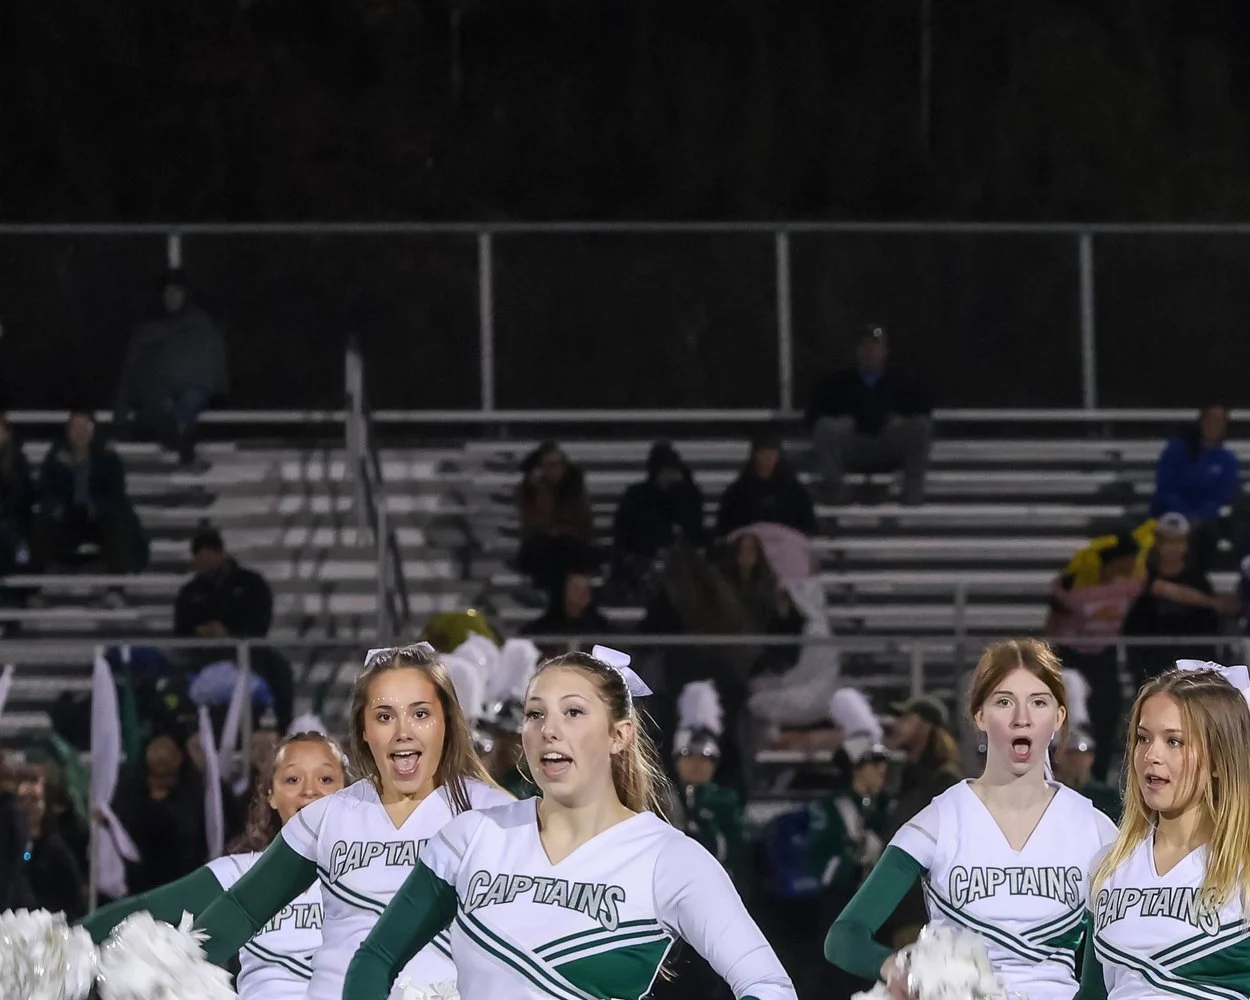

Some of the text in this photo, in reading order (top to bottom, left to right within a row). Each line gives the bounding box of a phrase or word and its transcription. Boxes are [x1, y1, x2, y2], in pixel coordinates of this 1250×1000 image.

[328, 838, 430, 885] CAPTA
[463, 870, 626, 932] CAPTAINS
[950, 866, 1082, 910] CAPTAINS
[1093, 886, 1224, 938] CAPTAINS
